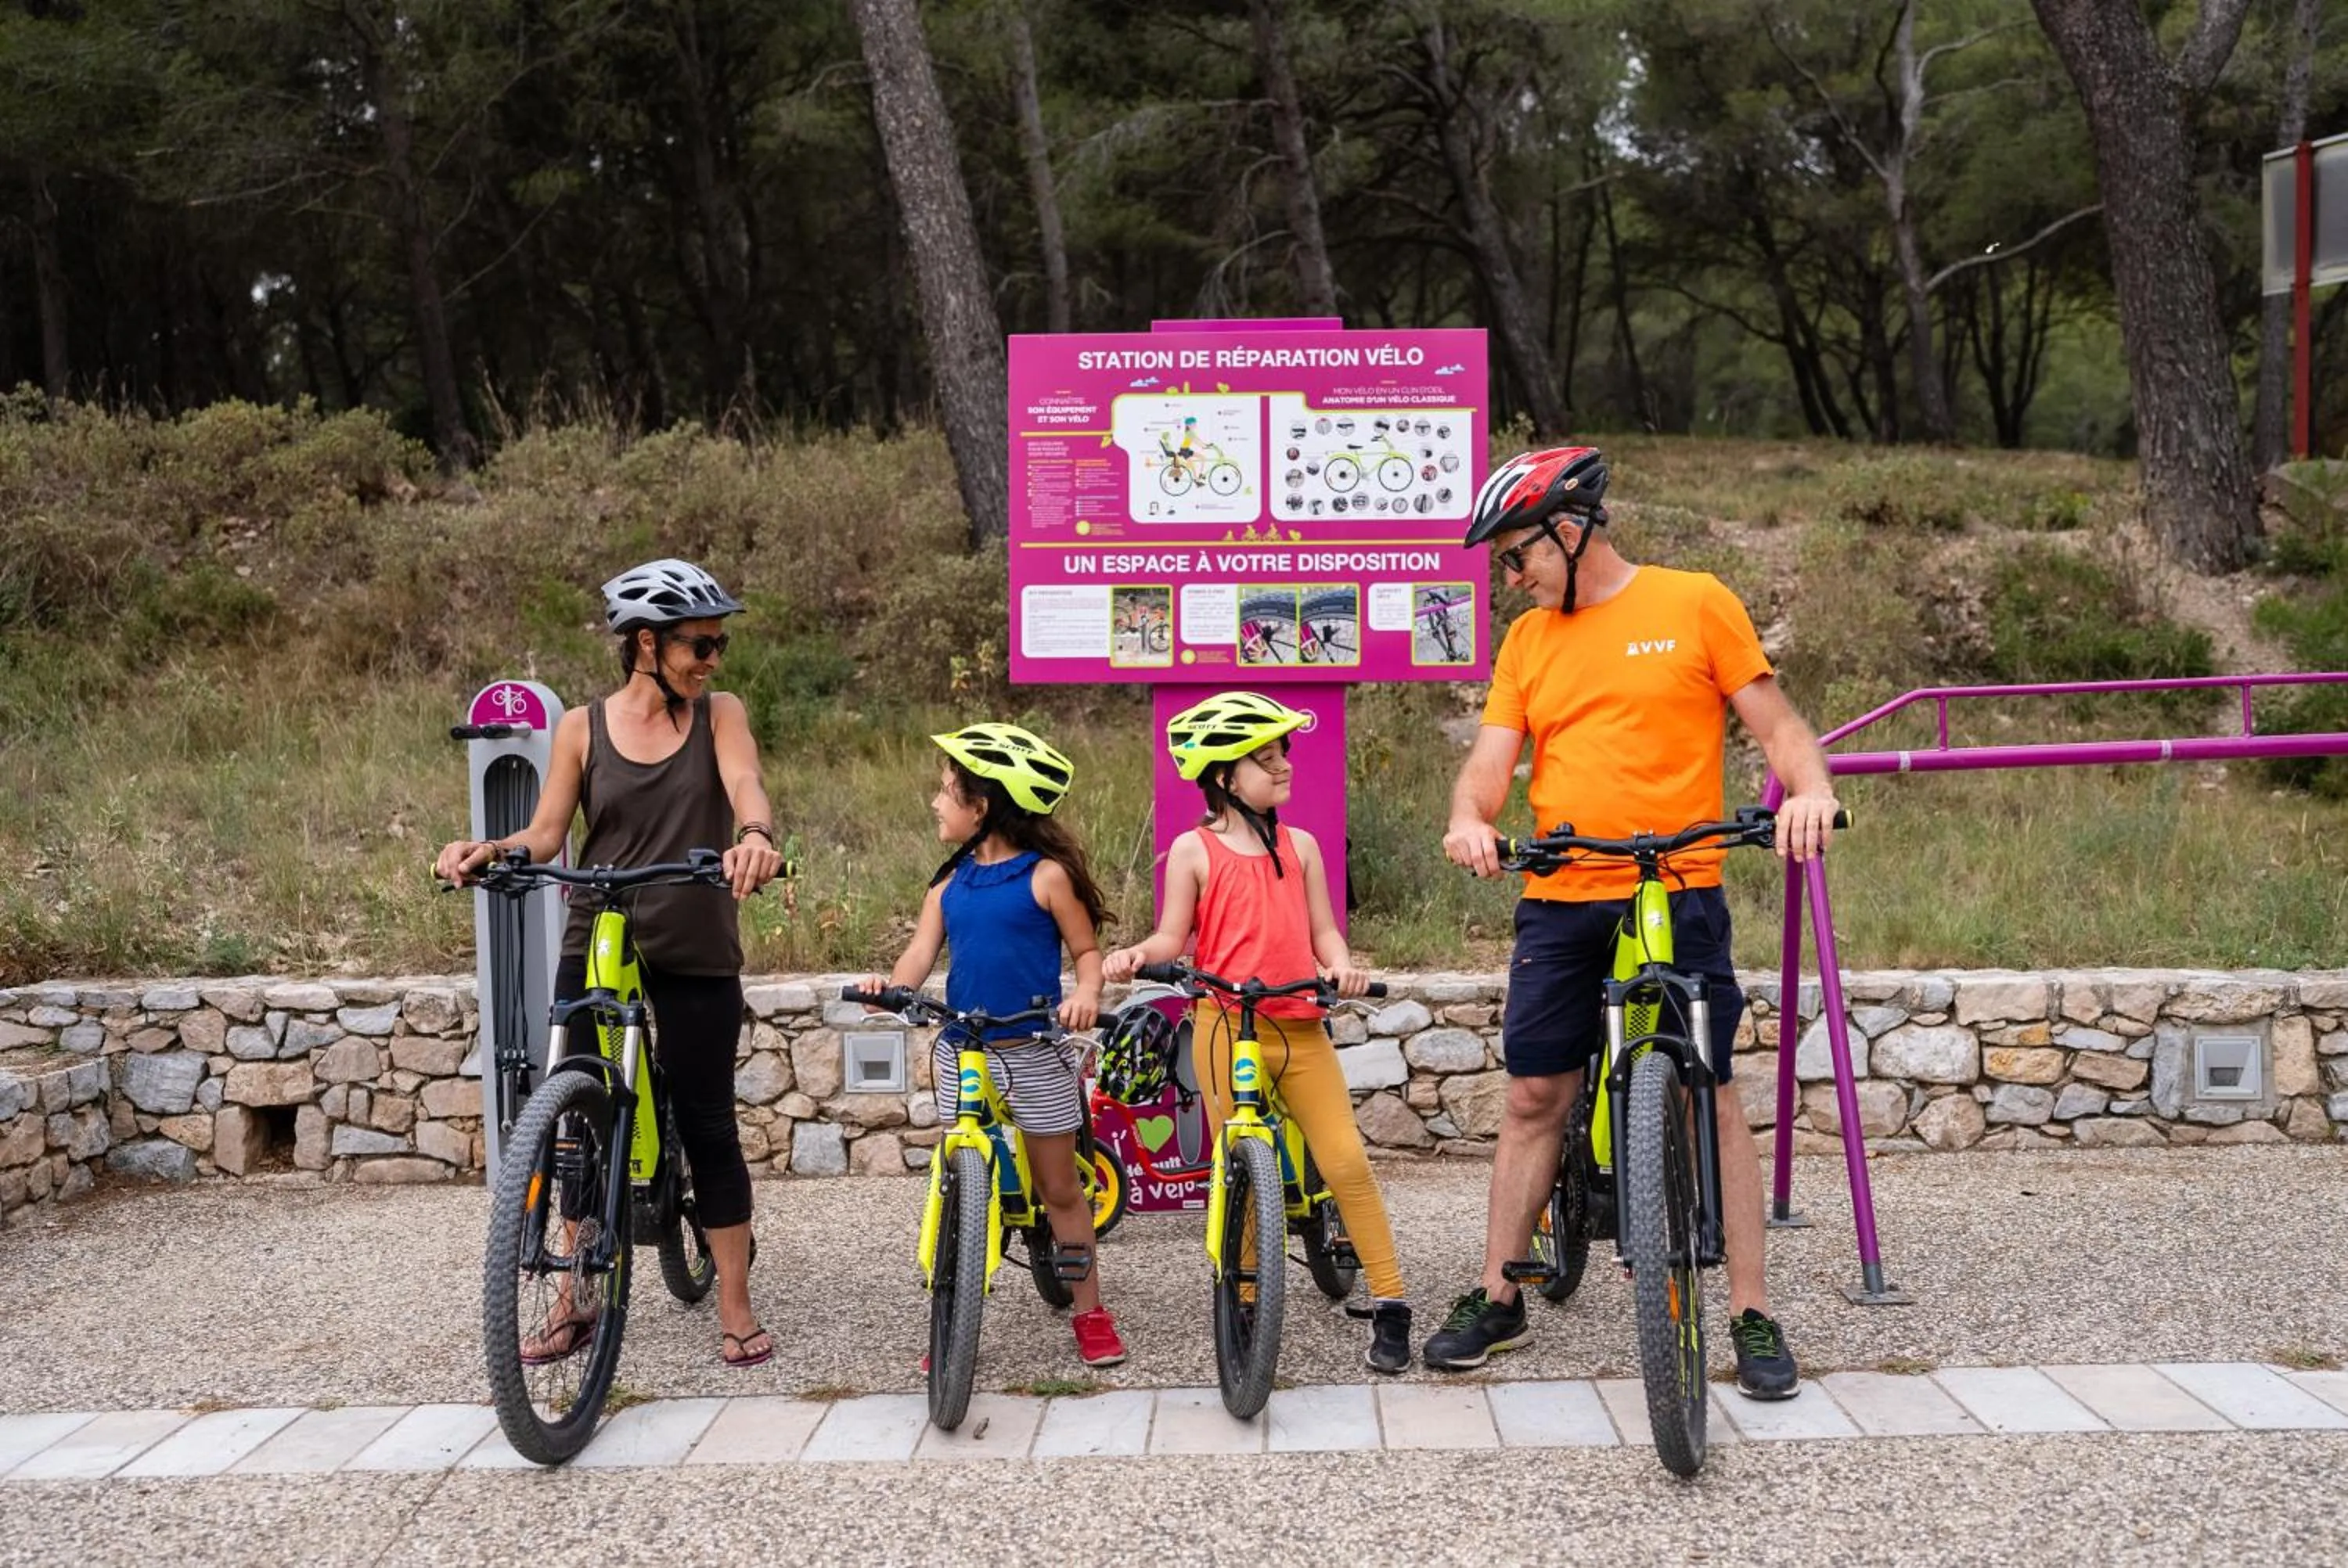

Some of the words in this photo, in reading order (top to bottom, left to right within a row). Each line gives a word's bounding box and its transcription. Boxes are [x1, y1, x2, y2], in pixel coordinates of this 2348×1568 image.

[1078, 350, 1173, 370] STATION
[1179, 350, 1211, 369] DE
[1215, 345, 1359, 368] RÉPARATION
[1365, 343, 1424, 366] VÉLO
[1323, 396, 1366, 405] ANATOMIE
[1388, 394, 1410, 404] VÉLO
[1411, 395, 1457, 404] CLASSIQUE
[1028, 406, 1045, 415] SON
[1046, 405, 1097, 415] ÉQUIPEMENT
[1068, 414, 1090, 423] VÉLO
[1064, 555, 1097, 574] UN
[1102, 554, 1190, 574] ESPACE
[1195, 550, 1212, 572] À
[1216, 553, 1292, 572] VOTRE
[1298, 552, 1440, 572] DISPOSITION
[1129, 1178, 1143, 1205] à
